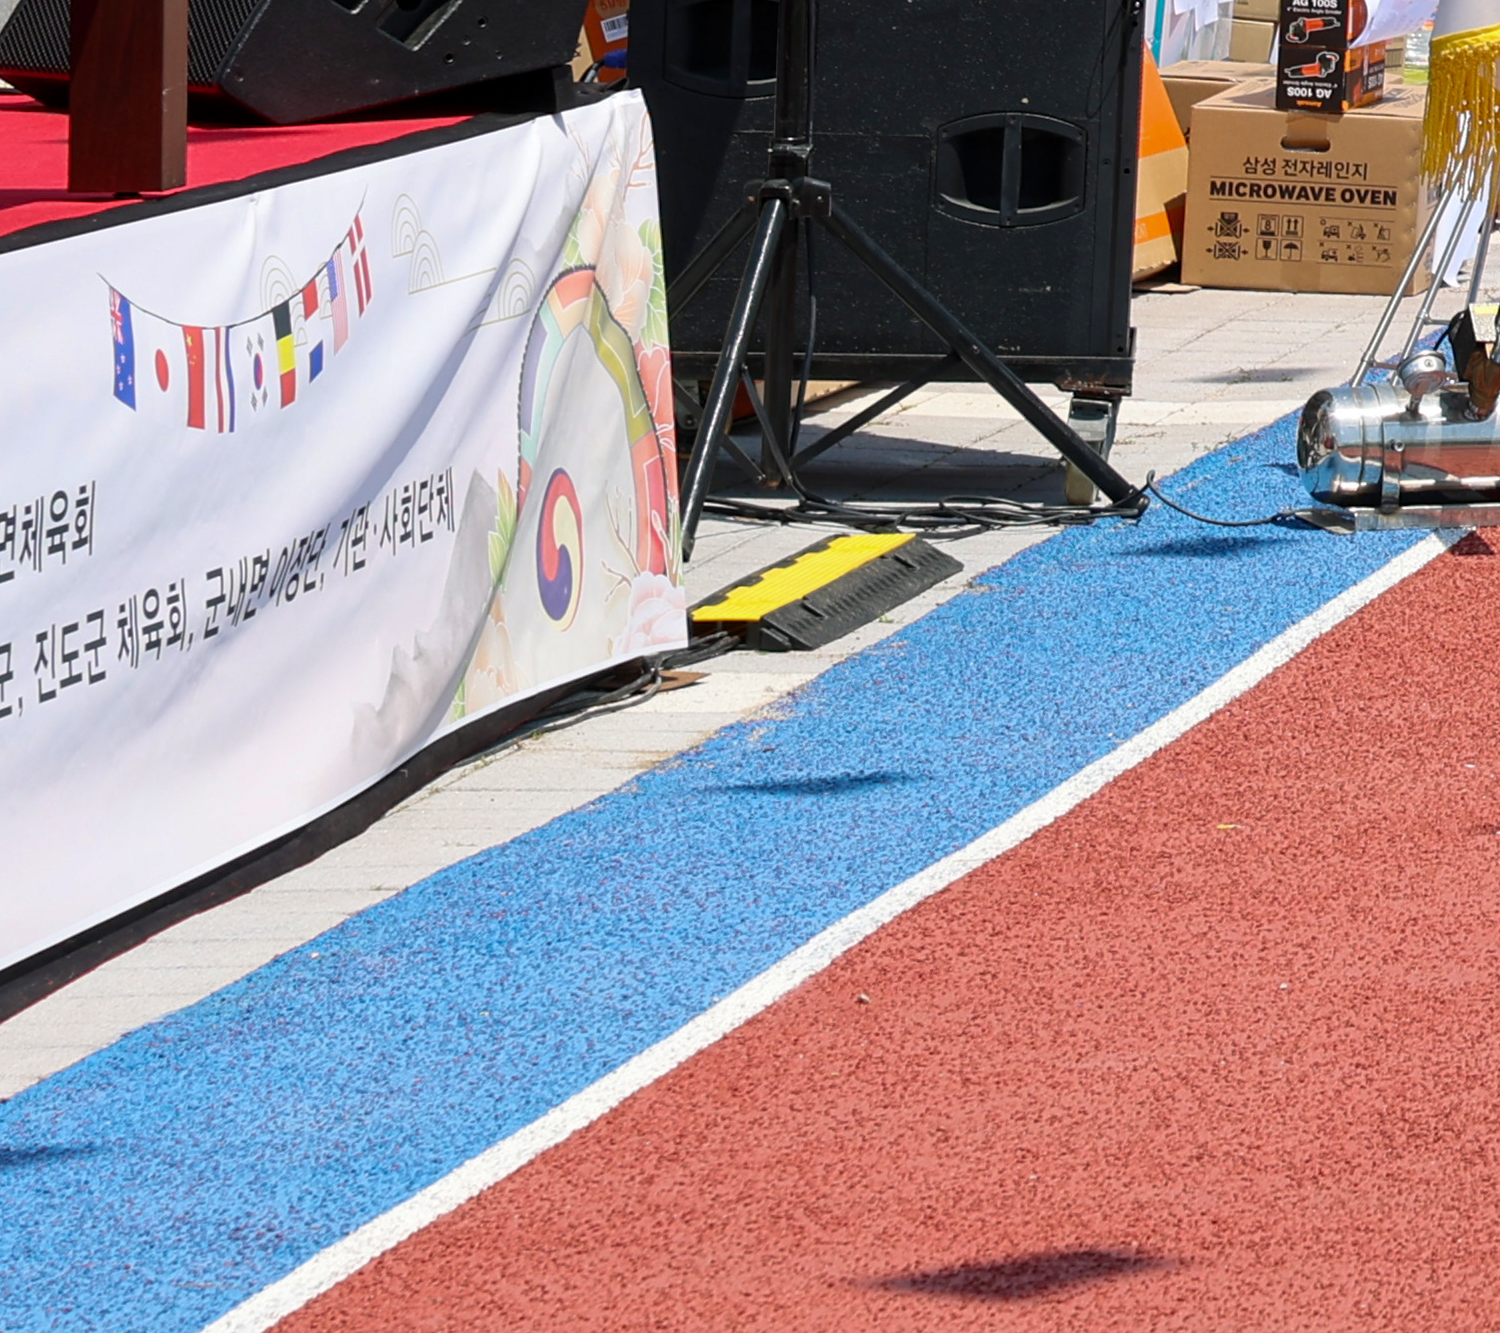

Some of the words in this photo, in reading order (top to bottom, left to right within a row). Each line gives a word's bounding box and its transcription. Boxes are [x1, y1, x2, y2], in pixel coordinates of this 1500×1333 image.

[1287, 86, 1313, 97] 100S
[1316, 89, 1332, 99] AG
[1242, 156, 1277, 175] 삼성
[1282, 158, 1369, 181] 전자레인지
[1209, 180, 1337, 202] MICROWAVE
[1341, 187, 1397, 206] OVEN
[1264, 219, 1271, 230] 8
[34, 609, 107, 703] 진도군
[117, 578, 194, 669] 체육회,
[203, 548, 271, 641] 군내면
[269, 522, 331, 608] 이장단,
